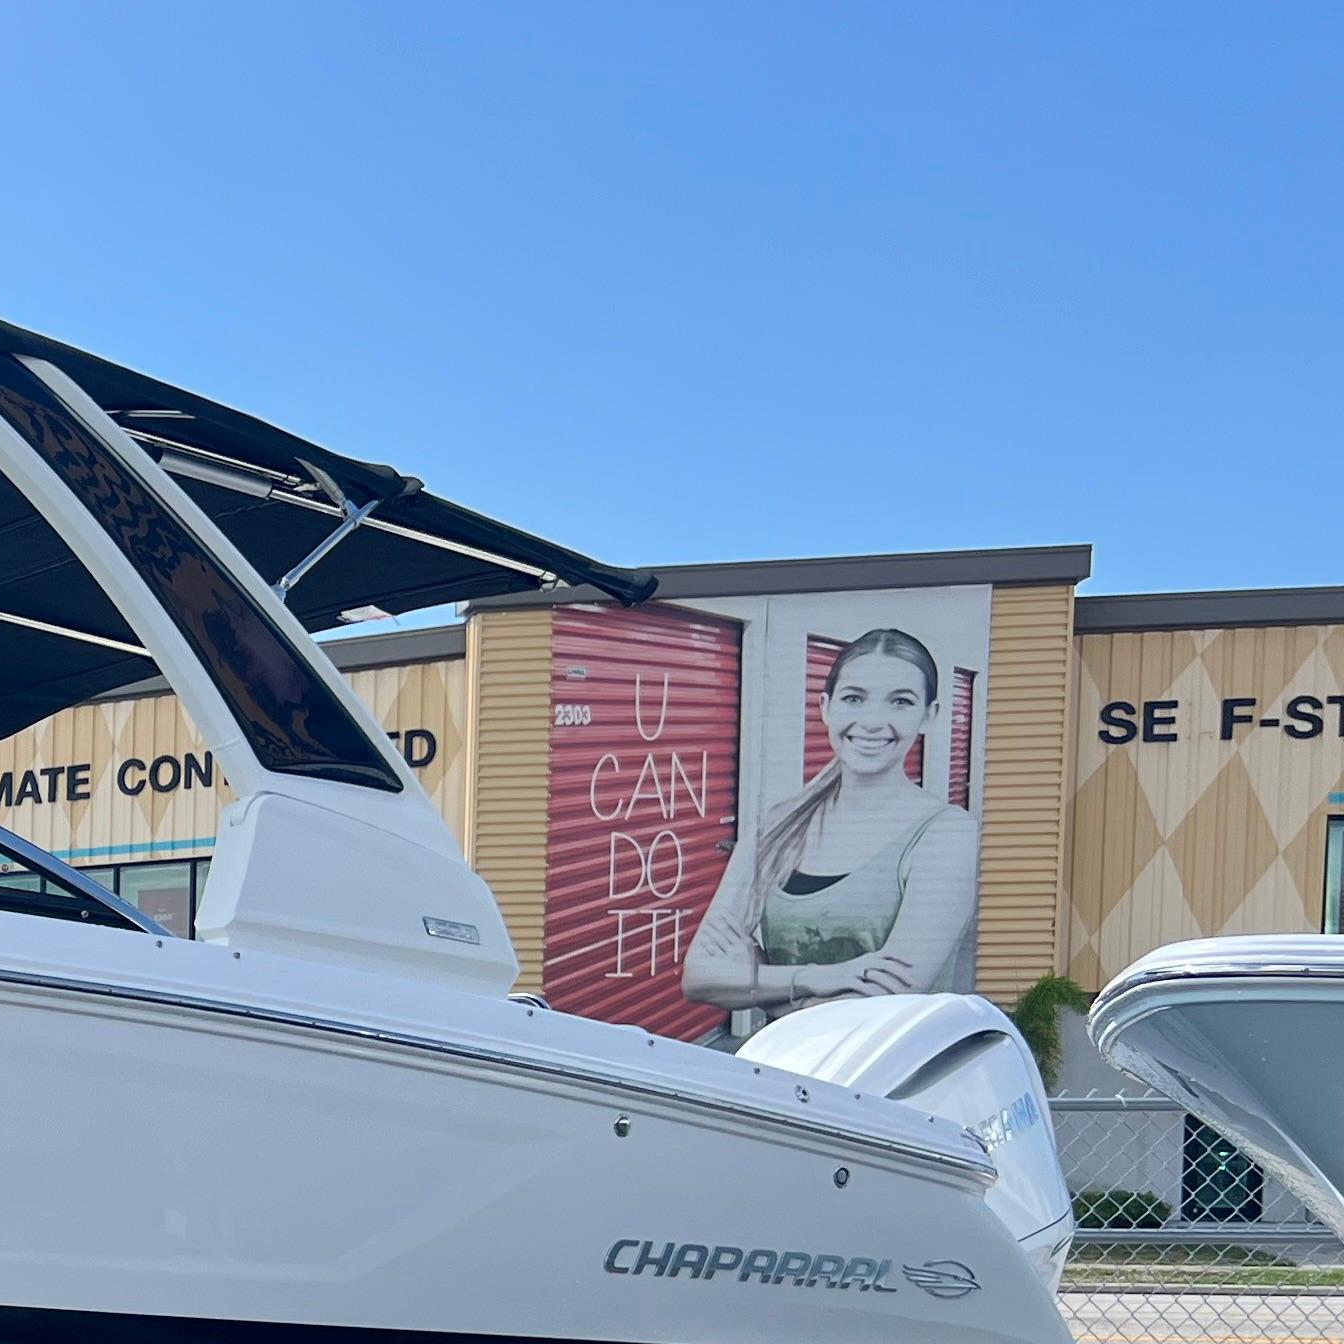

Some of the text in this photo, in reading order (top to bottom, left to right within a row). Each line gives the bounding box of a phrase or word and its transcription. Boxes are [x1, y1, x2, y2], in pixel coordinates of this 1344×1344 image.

[554, 703, 591, 726] 2303
[635, 672, 669, 741] U
[590, 750, 707, 821] CAN
[609, 830, 683, 899] DO
[605, 908, 682, 977] IT!
[603, 1239, 897, 1293] CHAPARRAL
